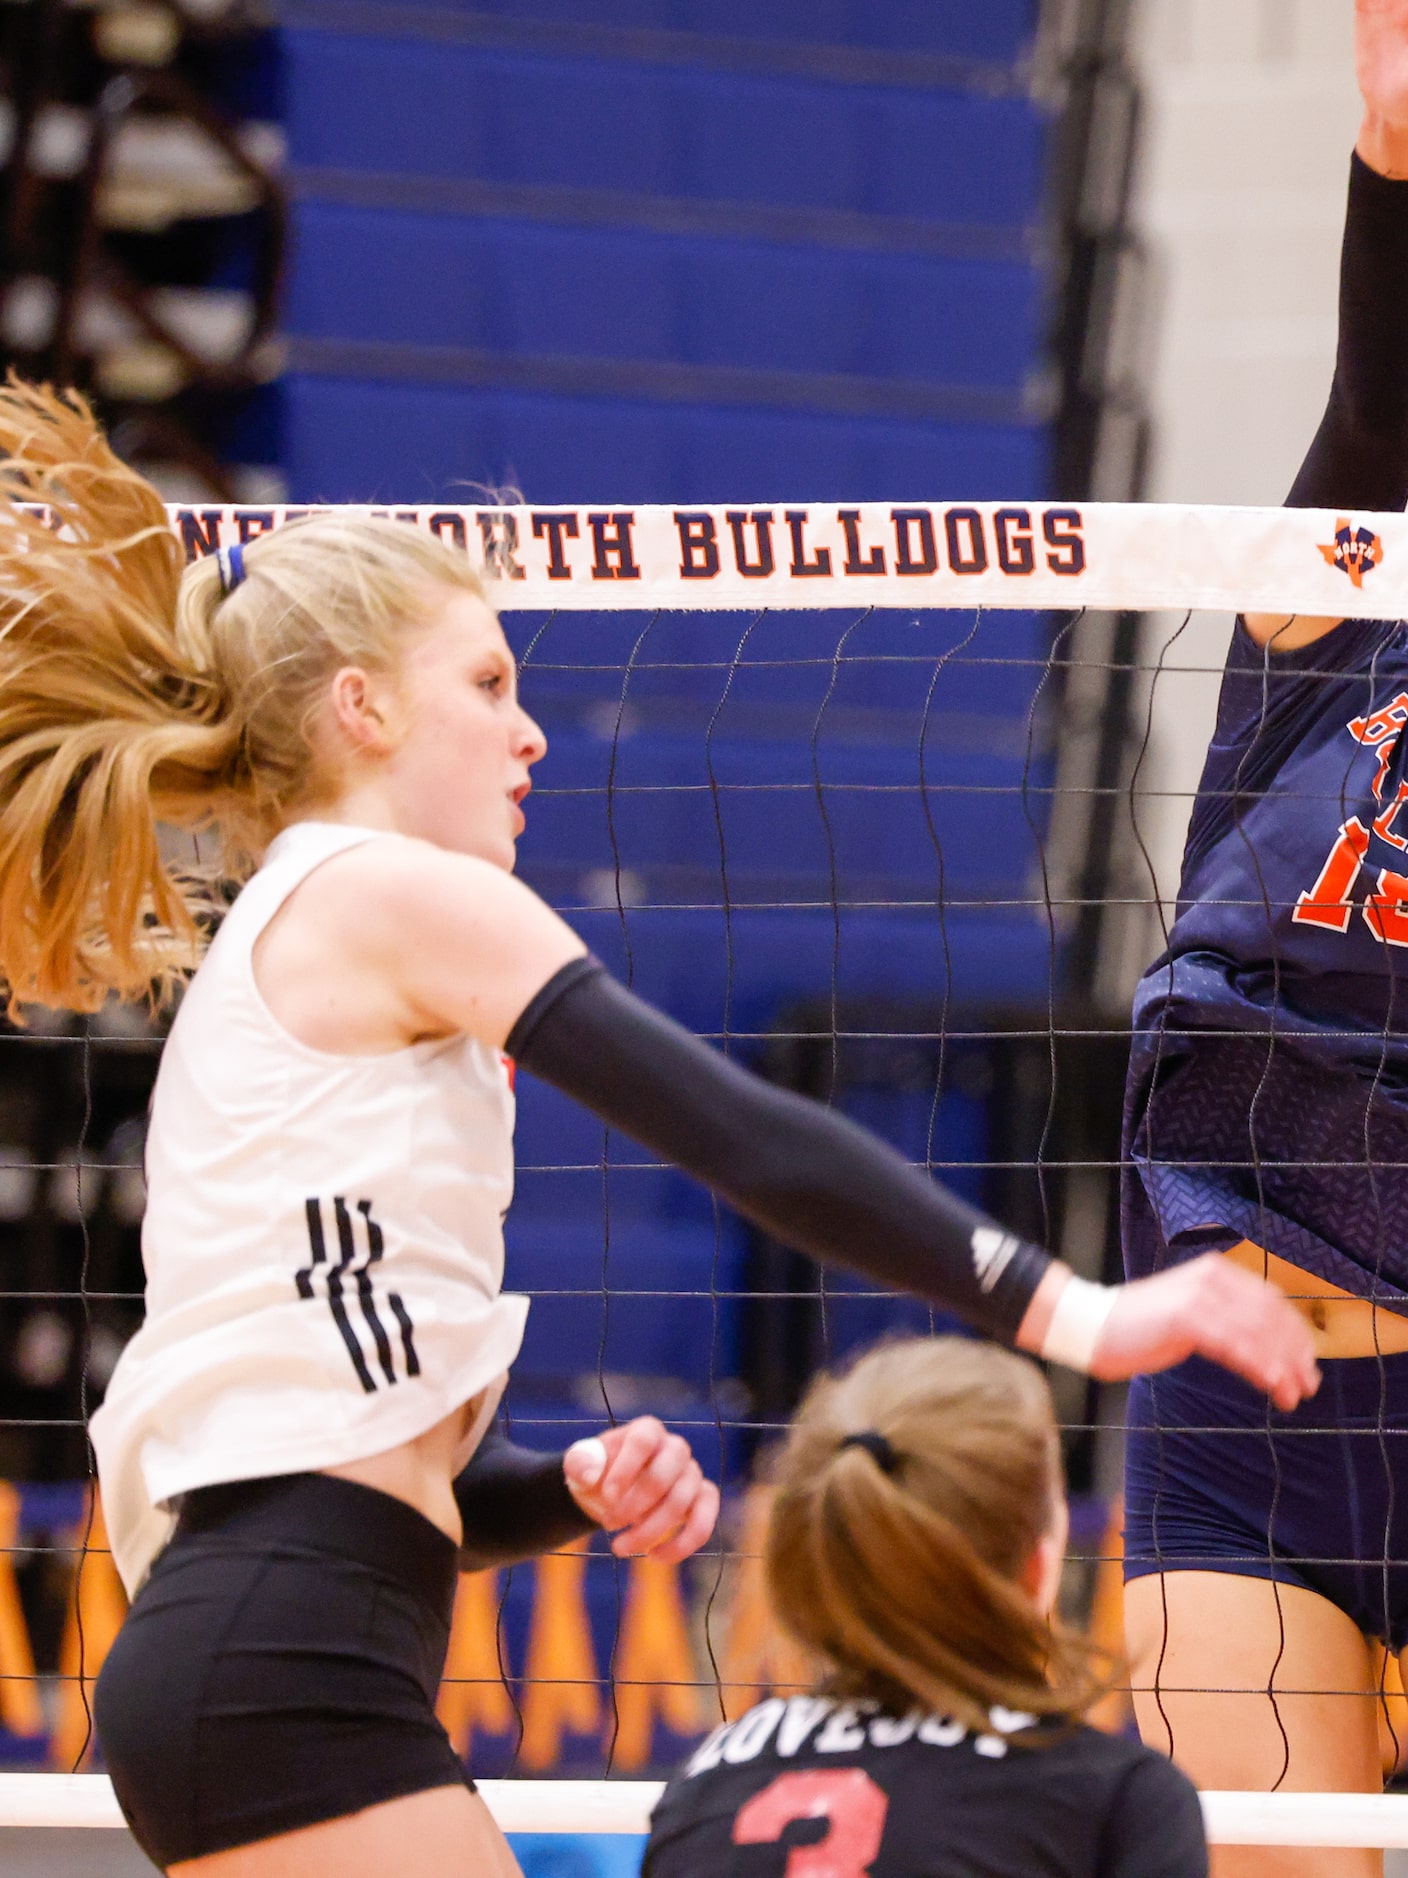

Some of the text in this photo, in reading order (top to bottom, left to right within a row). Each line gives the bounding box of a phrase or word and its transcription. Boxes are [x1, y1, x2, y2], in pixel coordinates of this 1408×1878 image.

[371, 507, 642, 581] ORTH
[673, 507, 1087, 580] BULLDOGS
[1334, 540, 1376, 561] NORTH
